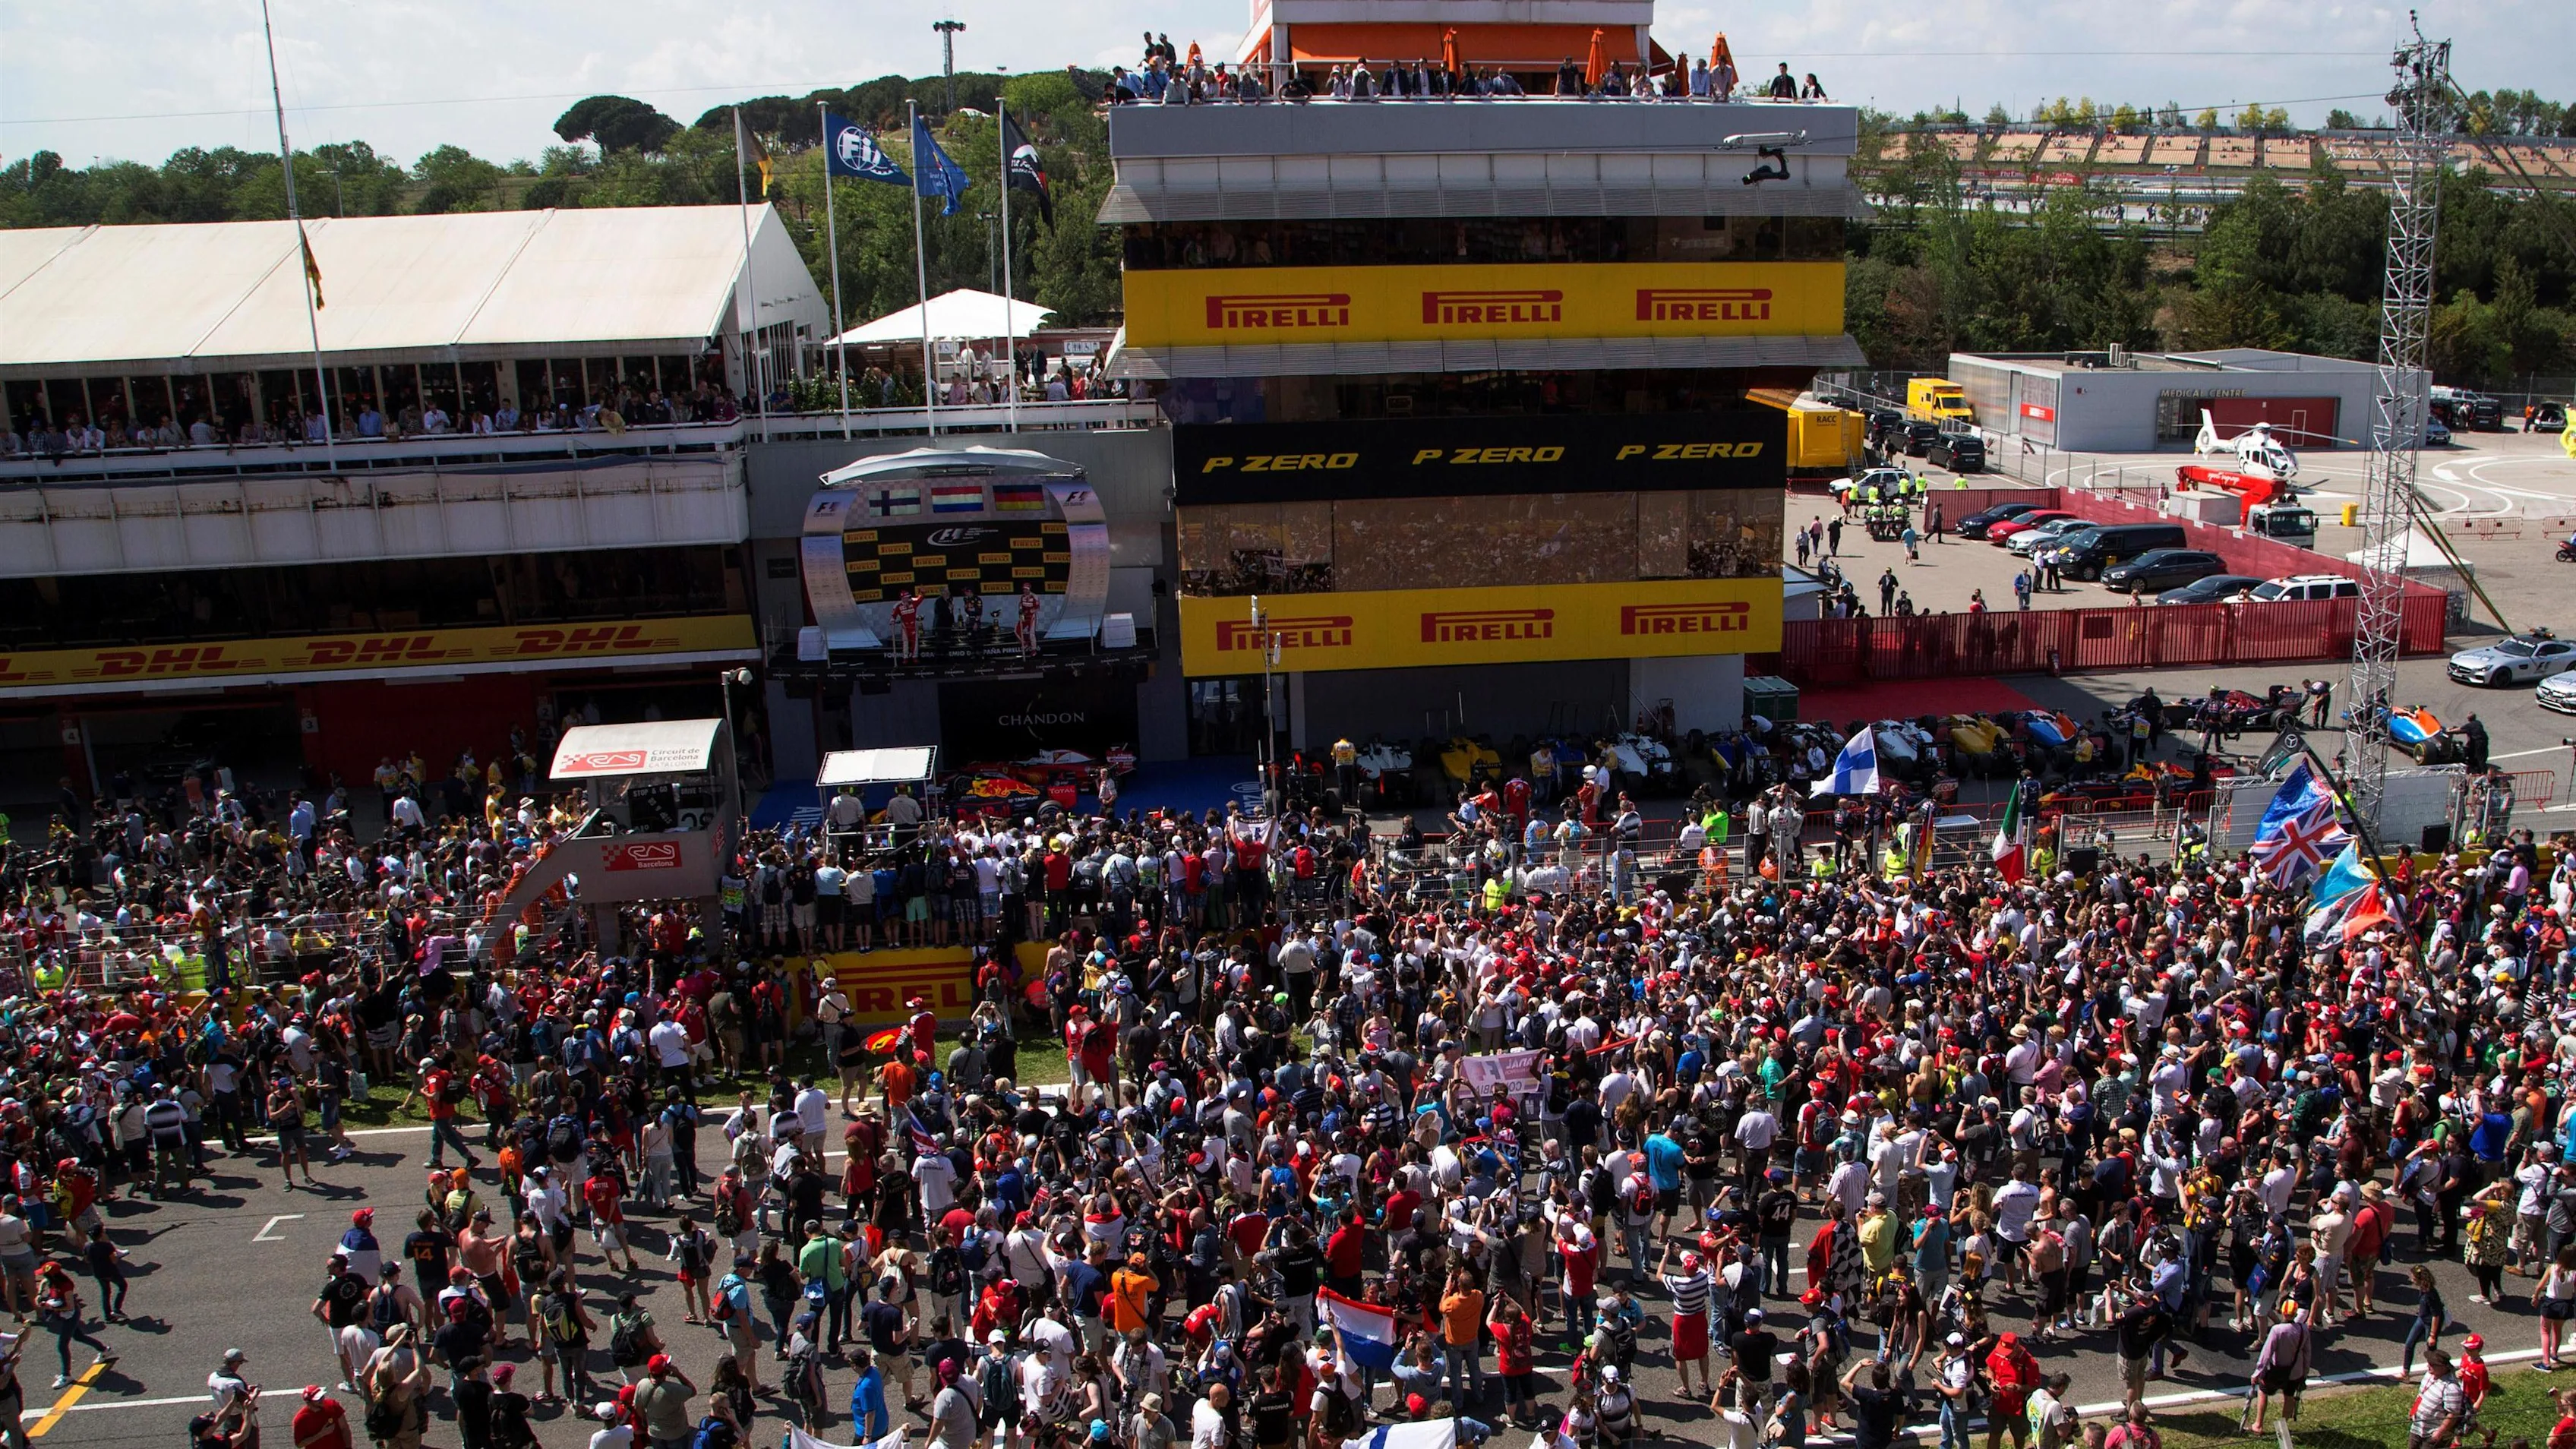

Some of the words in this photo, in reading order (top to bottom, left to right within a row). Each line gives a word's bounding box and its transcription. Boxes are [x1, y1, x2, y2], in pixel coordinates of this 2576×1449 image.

[1206, 293, 1350, 328] PIRELLI
[1422, 290, 1563, 324] PIRELLI
[1636, 288, 1773, 320] PIRELLI
[2161, 389, 2205, 397] MEDICAL
[2208, 389, 2247, 398] CENTRE
[1412, 449, 1444, 466] P
[1449, 446, 1565, 465] ZERO
[1615, 444, 1646, 460] P
[1652, 442, 1763, 460] ZERO
[1202, 456, 1234, 473] P
[1240, 453, 1359, 472] ZERO
[1420, 608, 1555, 642] PIRELLI
[1621, 601, 1750, 635] PIRELLI
[513, 625, 655, 654] DHL
[1217, 616, 1353, 652] PIRELLI
[305, 636, 447, 665] DHL
[95, 646, 240, 677] DHL
[306, 720, 313, 729] 3
[999, 712, 1084, 726] CHANDON
[68, 732, 75, 740] 4
[651, 753, 699, 762] Barcelona
[638, 860, 674, 869] Barcelona
[1771, 1204, 1791, 1221] 44
[414, 1248, 434, 1261] 14
[1289, 1257, 1313, 1266] PETRONAS
[1260, 1403, 1290, 1412] PETRONAS
